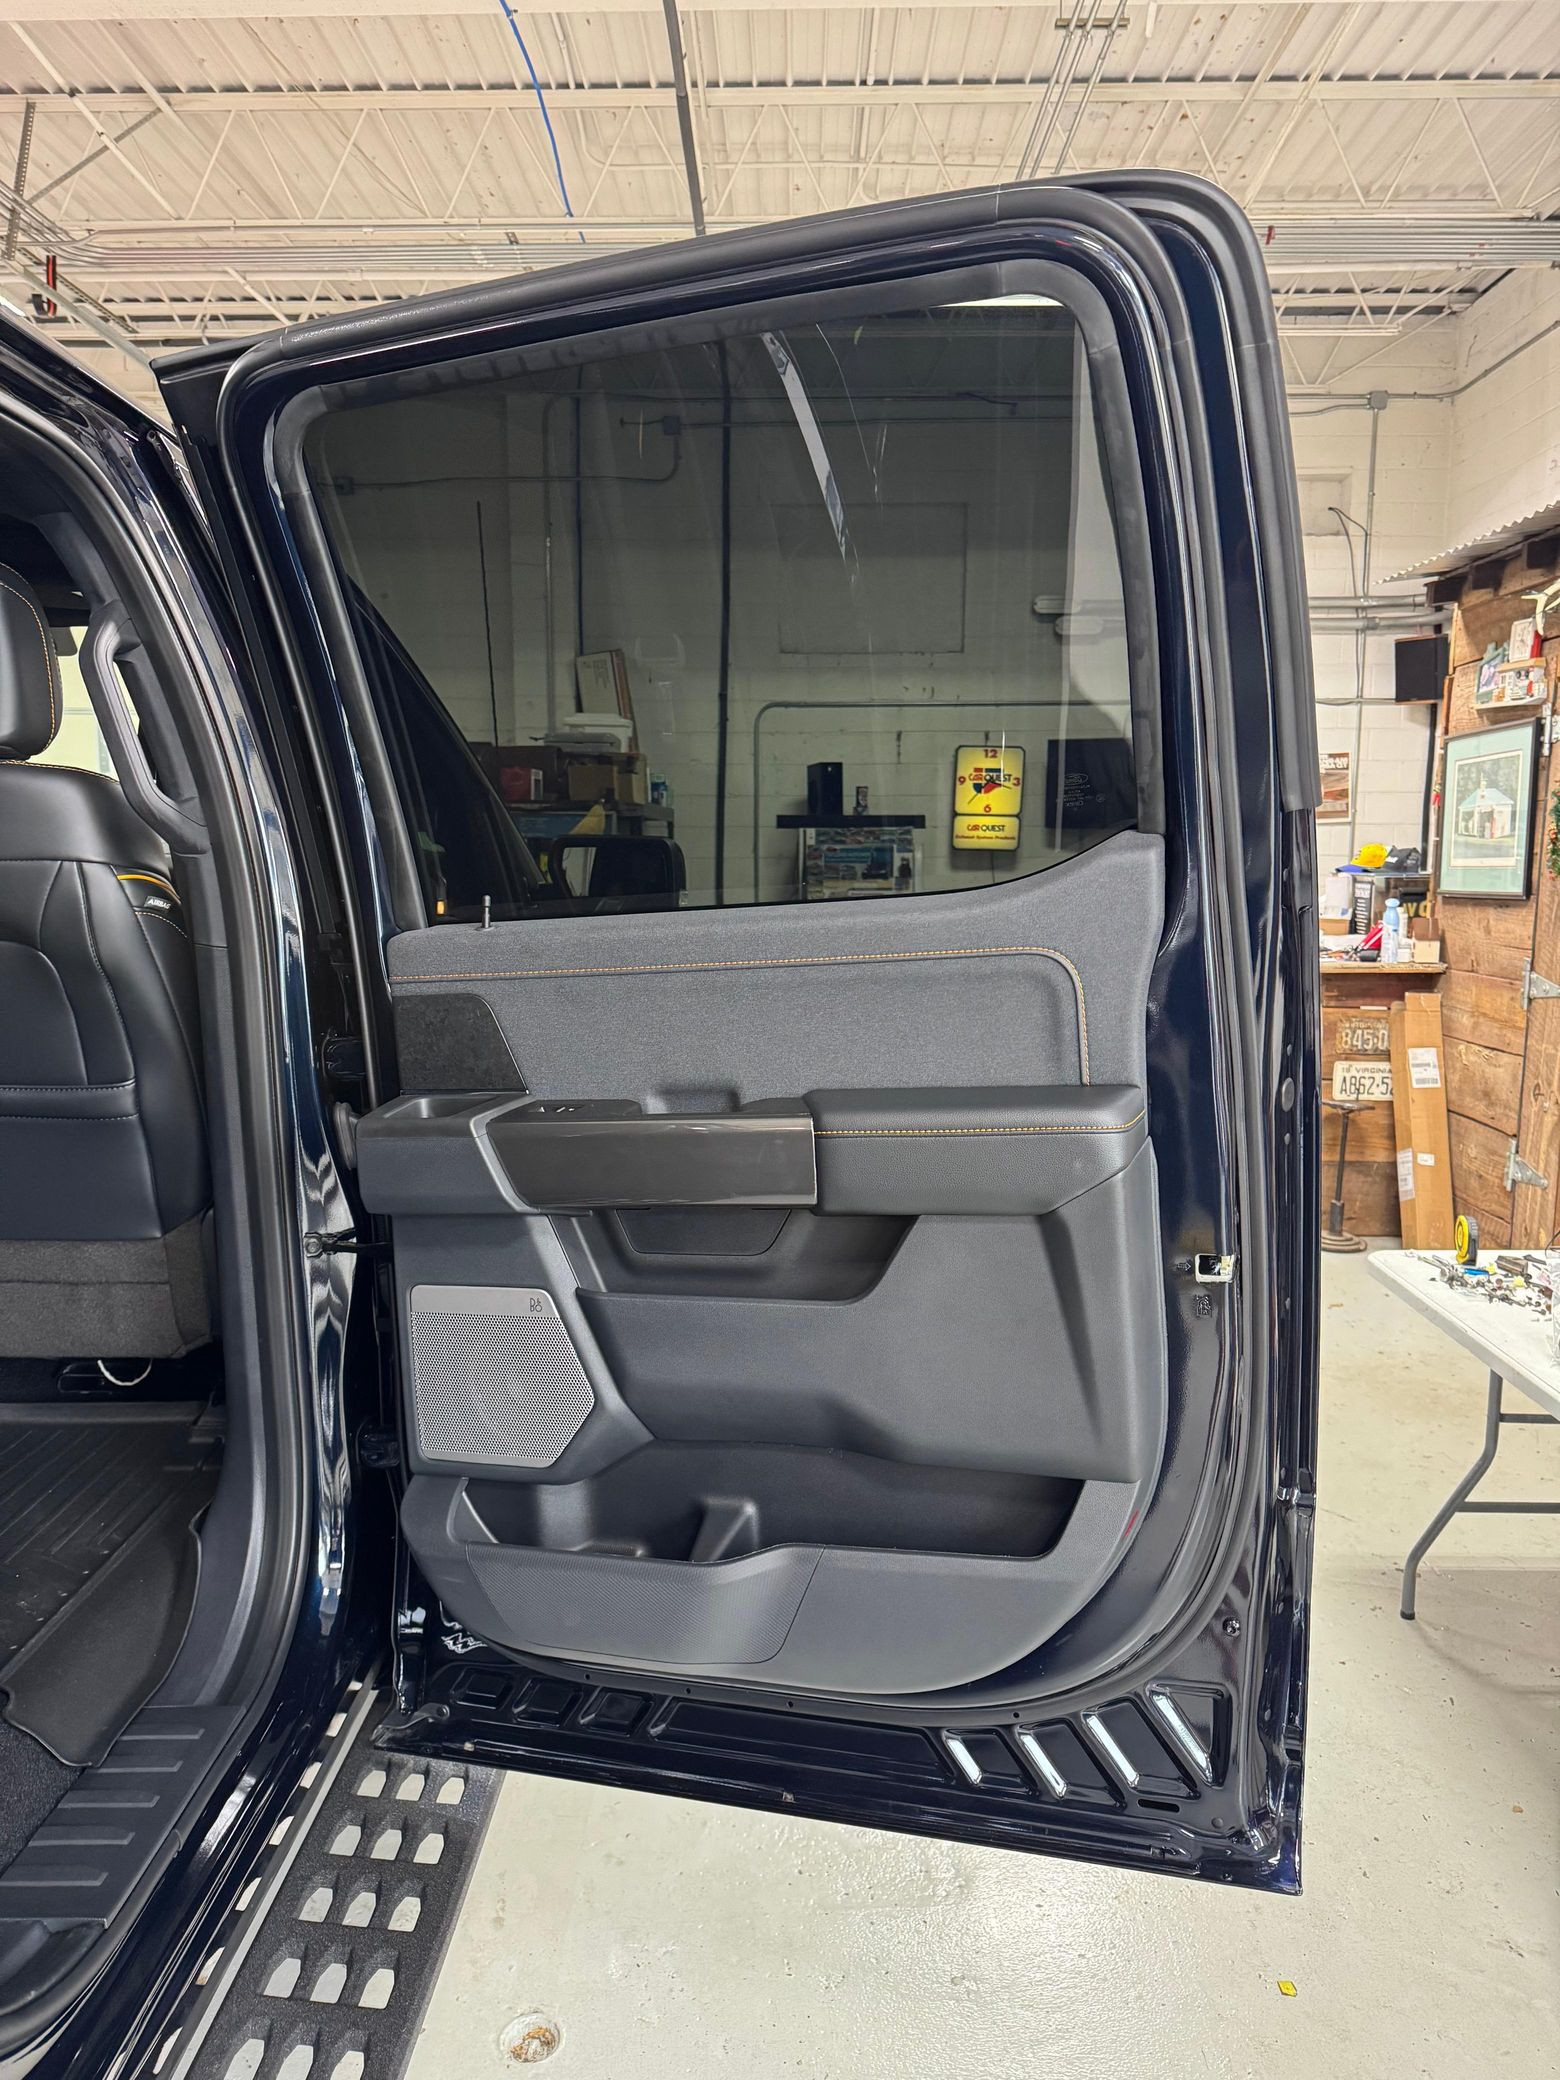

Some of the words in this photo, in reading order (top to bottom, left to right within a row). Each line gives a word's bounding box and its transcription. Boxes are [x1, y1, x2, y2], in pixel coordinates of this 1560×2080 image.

[984, 749, 998, 758] 12
[958, 776, 966, 785] 9
[1013, 777, 1020, 786] 3
[984, 804, 992, 813] 6
